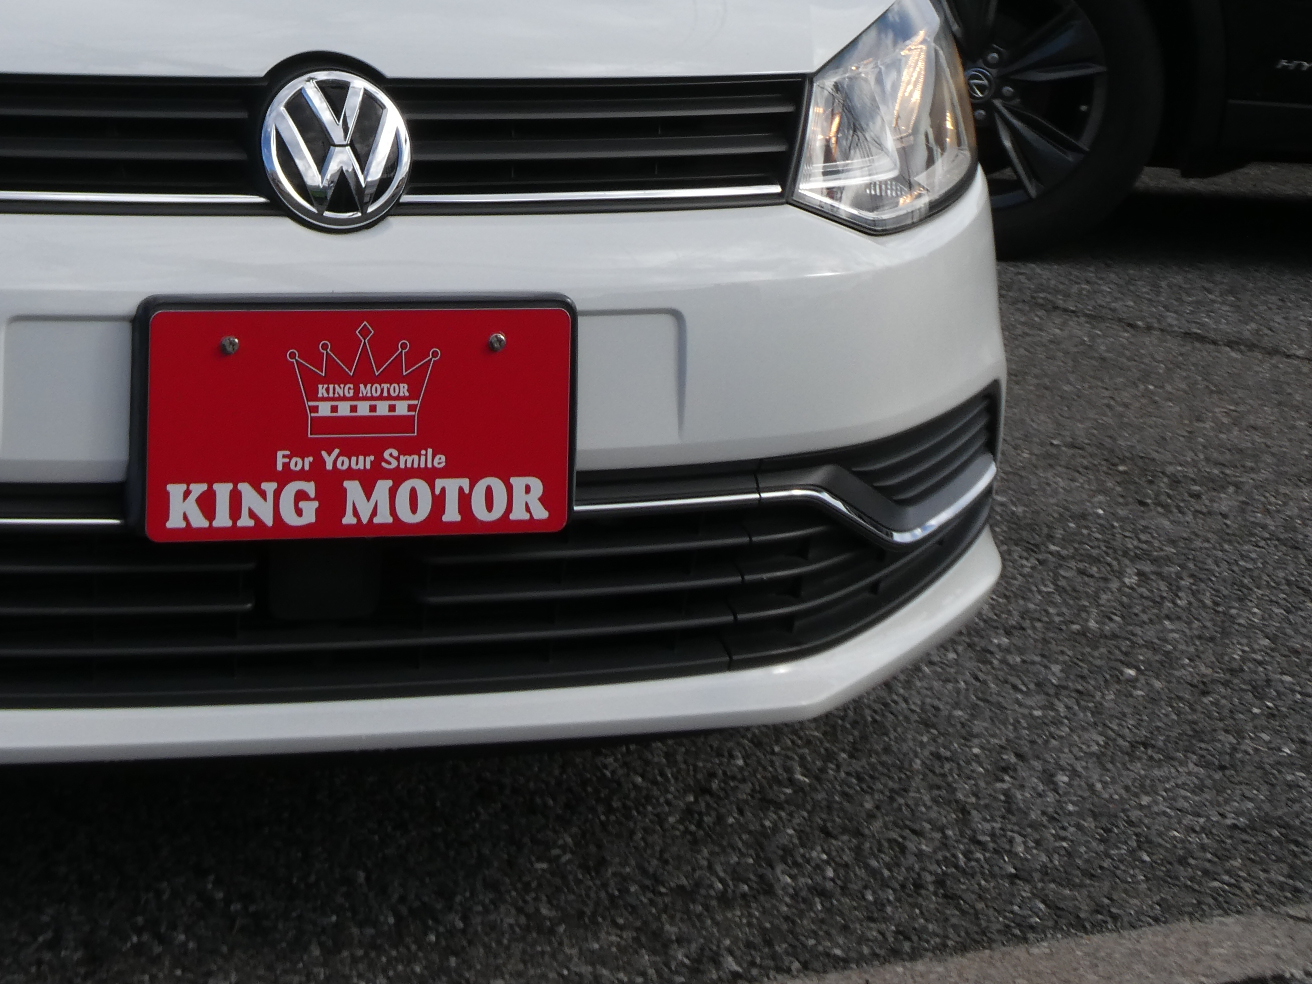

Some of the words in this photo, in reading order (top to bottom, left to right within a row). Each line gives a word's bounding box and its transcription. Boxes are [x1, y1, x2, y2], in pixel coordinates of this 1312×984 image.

[317, 384, 355, 398] KING
[358, 383, 410, 397] MOTOR
[276, 450, 313, 471] For
[321, 449, 374, 470] Your
[381, 448, 446, 469] Smile
[165, 481, 319, 529] KING
[342, 476, 549, 525] MOTOR
